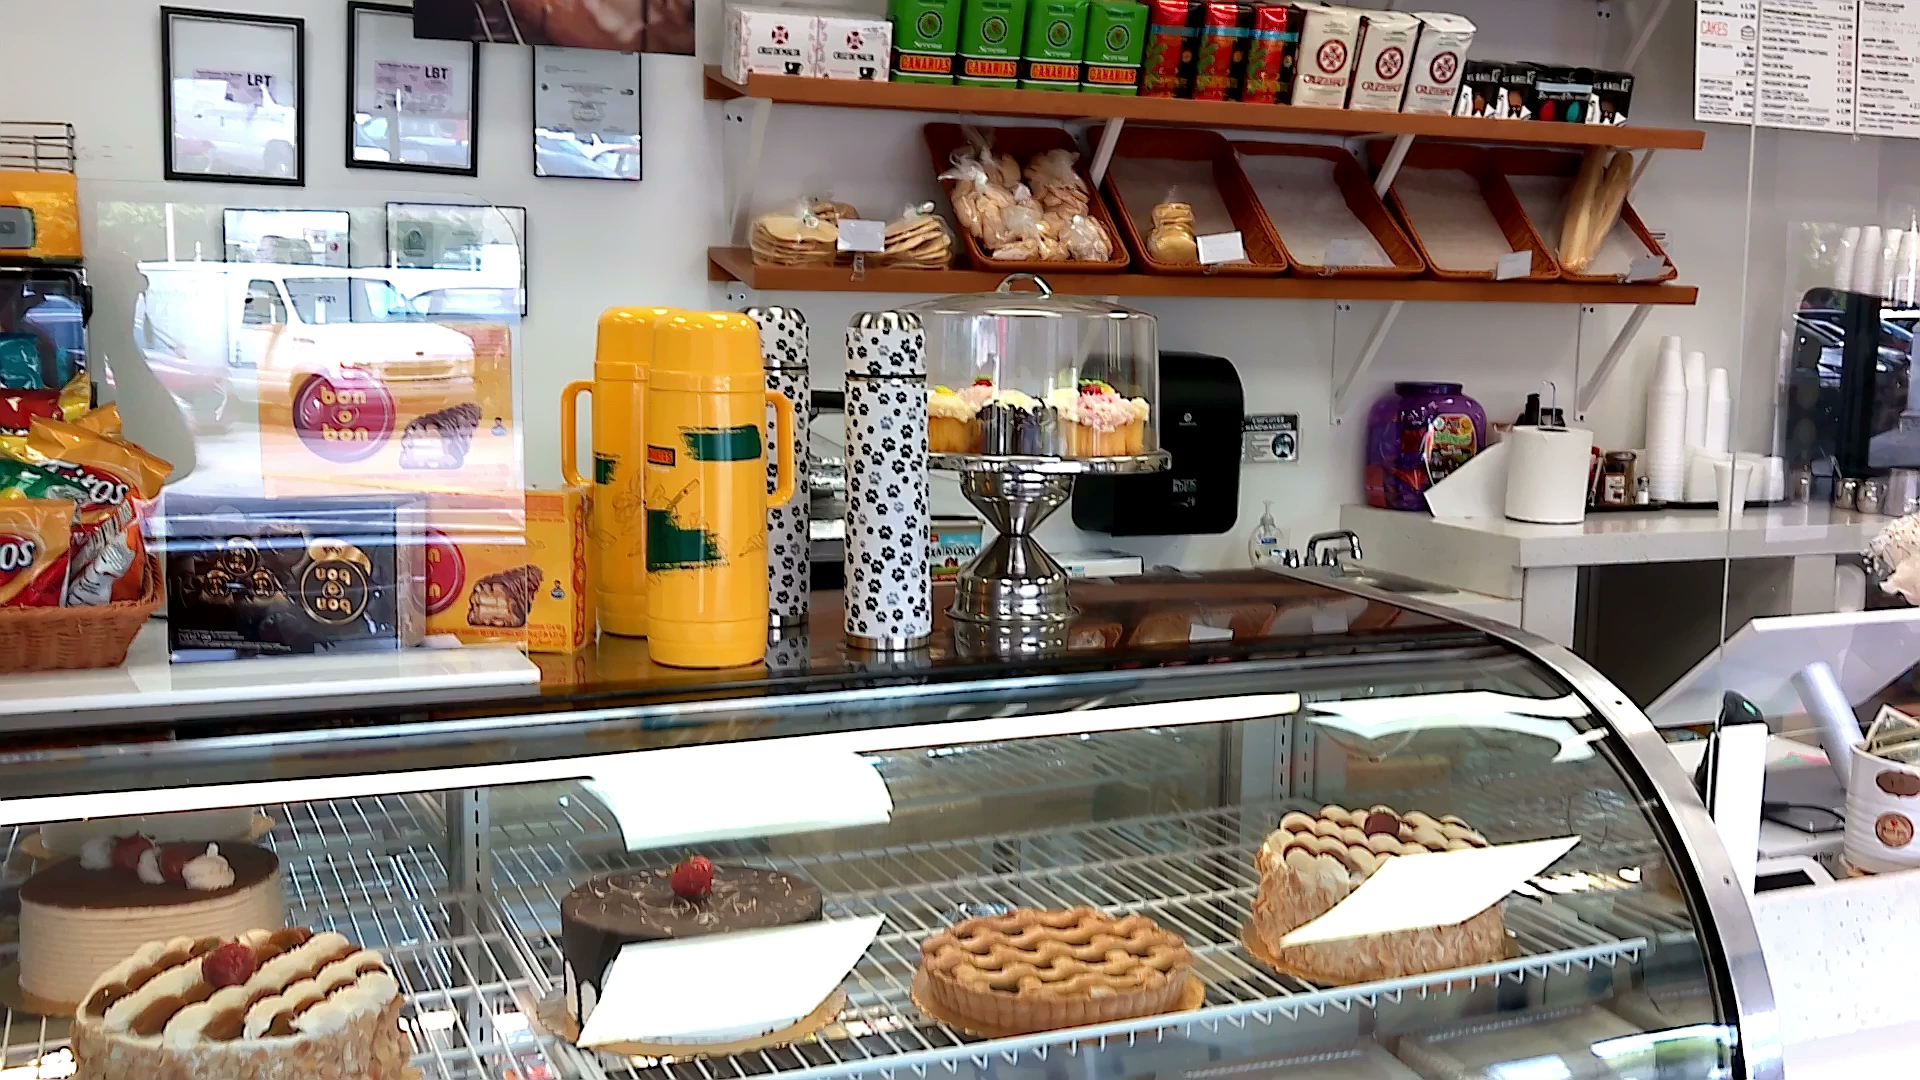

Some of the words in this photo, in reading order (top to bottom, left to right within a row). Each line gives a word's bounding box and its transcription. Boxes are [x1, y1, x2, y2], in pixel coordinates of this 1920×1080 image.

[1701, 20, 1728, 36] CAKES
[901, 55, 950, 72] CANARIAS
[966, 61, 1016, 77] CANARIAS
[247, 73, 273, 87] LBT
[425, 66, 449, 80] LBT
[1031, 64, 1078, 80] CANARIAS
[1089, 67, 1137, 83] CANARIAS
[320, 385, 367, 405] bon
[322, 423, 369, 442] bon
